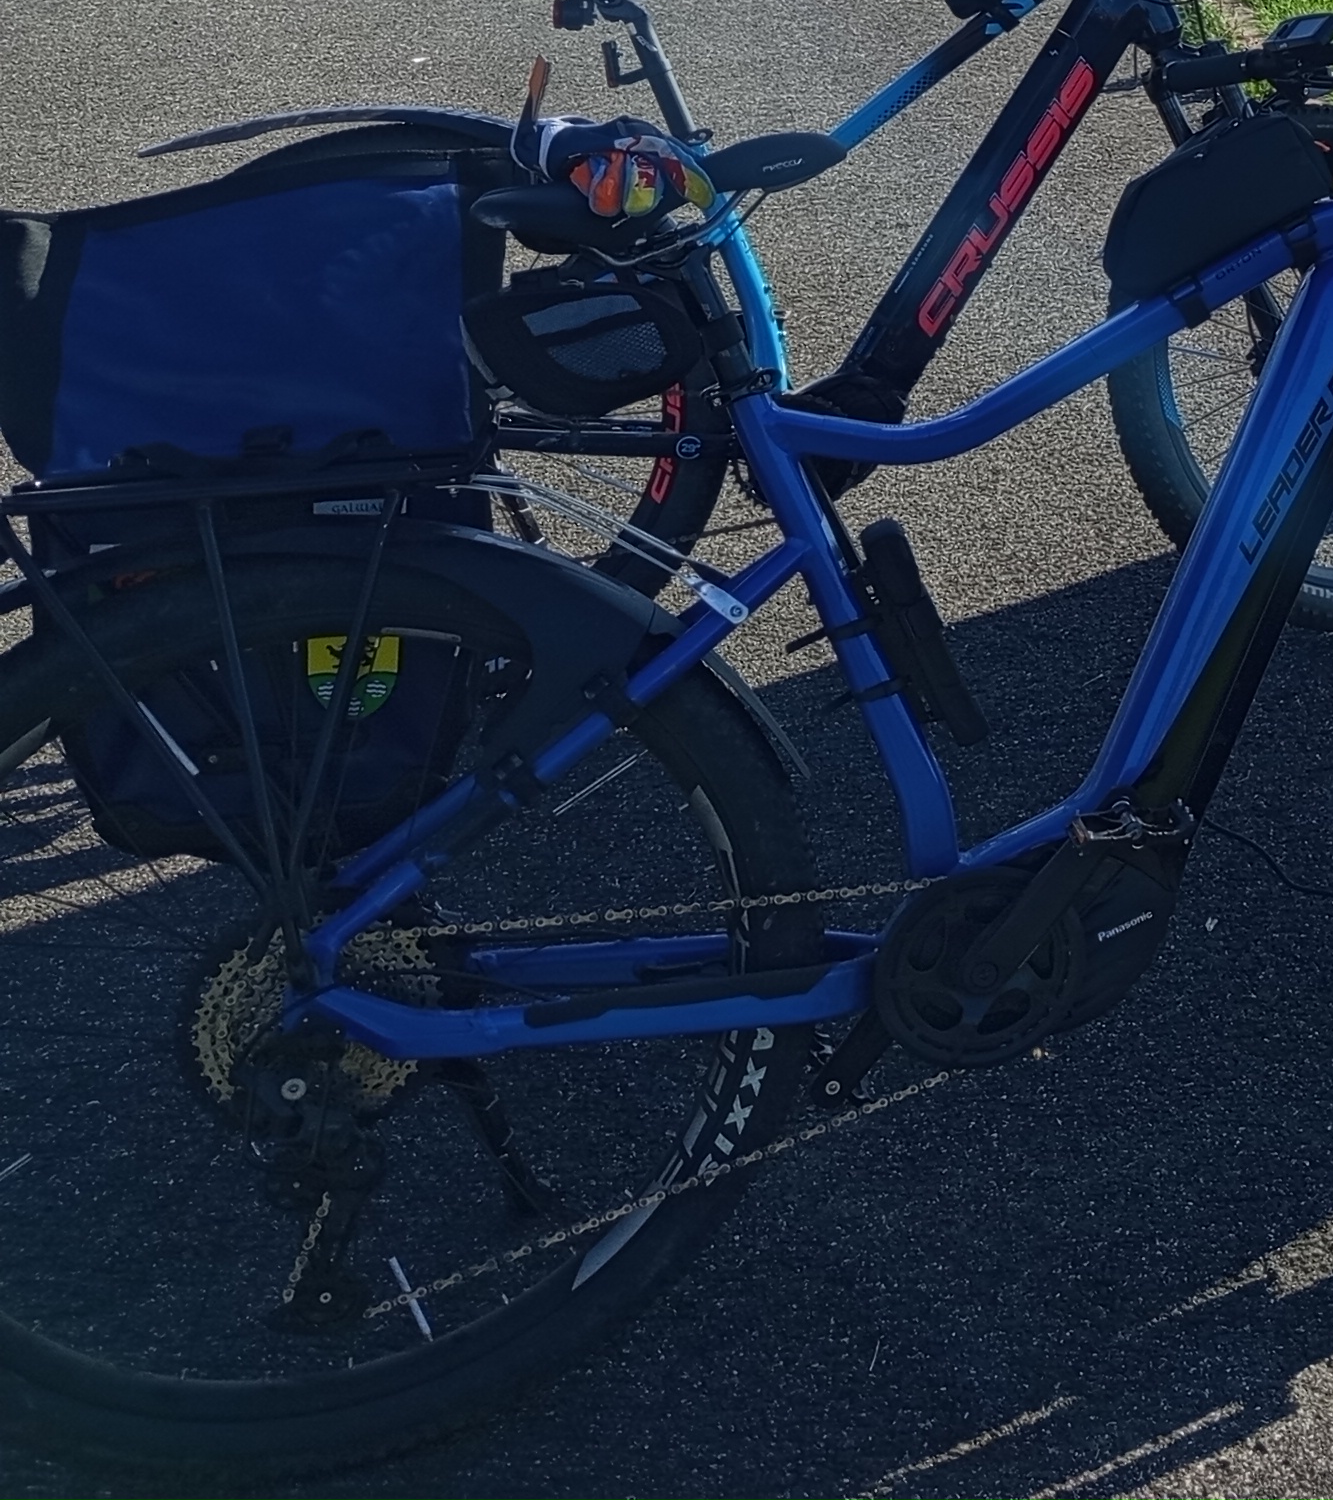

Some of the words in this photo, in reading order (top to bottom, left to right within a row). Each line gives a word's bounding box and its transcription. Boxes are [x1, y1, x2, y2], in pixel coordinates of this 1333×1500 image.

[918, 55, 1095, 337] CRUSSIS
[1238, 396, 1333, 566] LEADER
[1097, 910, 1154, 942] Panasonic
[699, 1027, 776, 1187] AXXIS
